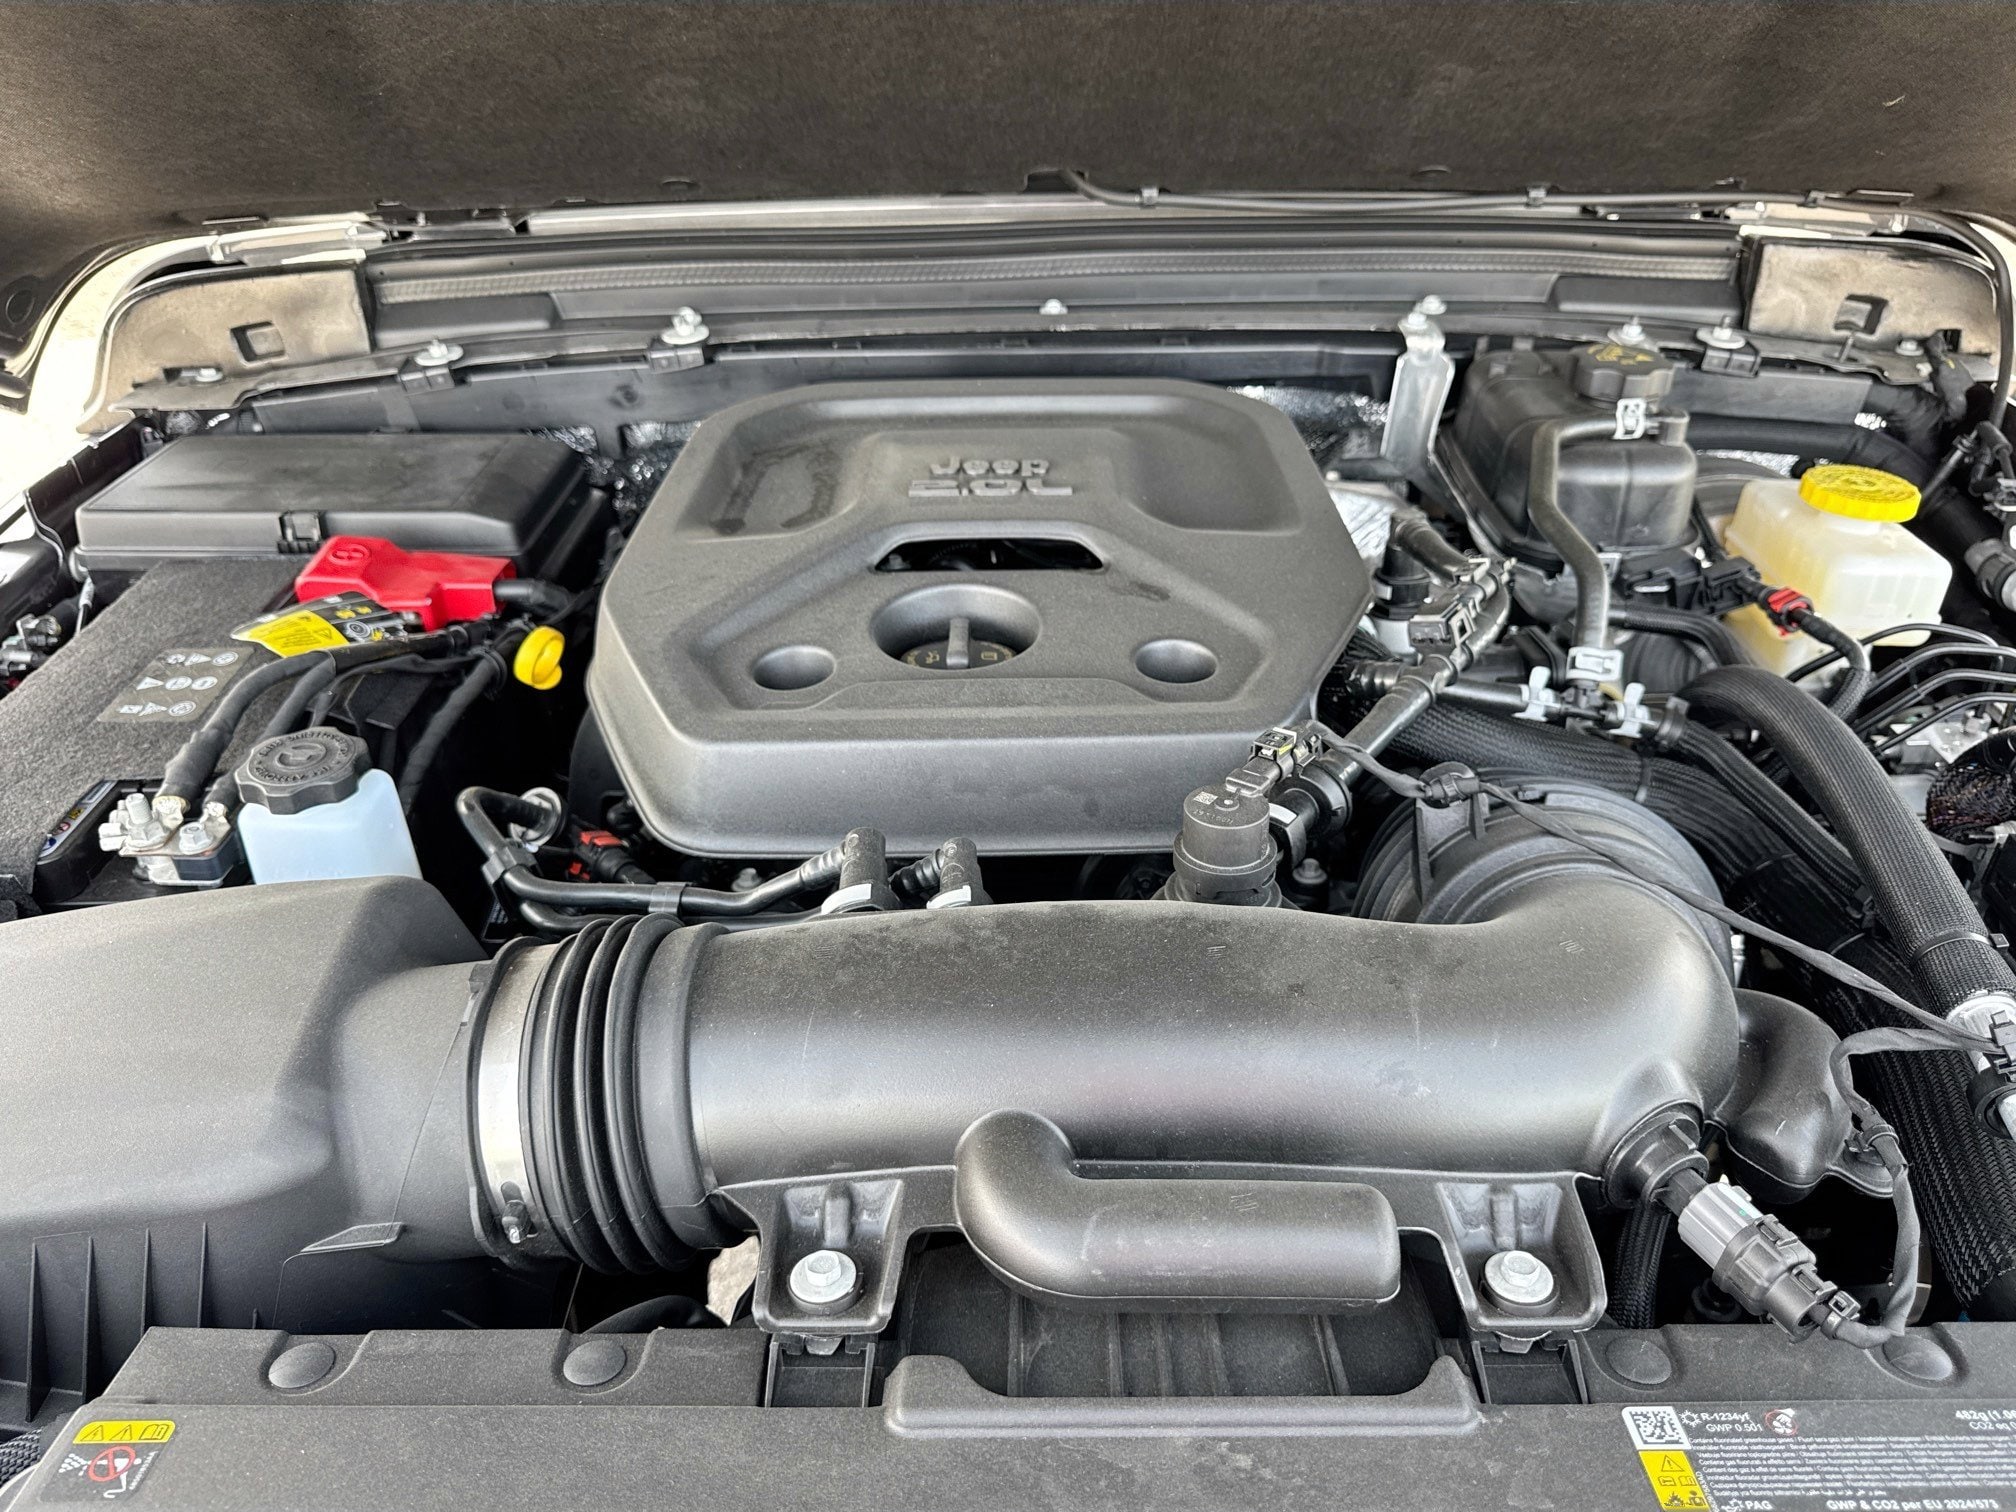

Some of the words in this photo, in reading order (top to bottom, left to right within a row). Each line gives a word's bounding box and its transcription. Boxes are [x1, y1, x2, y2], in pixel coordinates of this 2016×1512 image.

[930, 456, 1050, 477] Jeep
[908, 477, 1074, 497] 2.0L
[1700, 1412, 1751, 1422] R-1234yf
[1955, 1410, 1989, 1421] 482g
[1706, 1423, 1733, 1432] GWP
[1735, 1423, 1763, 1432] 0.501
[1969, 1421, 1994, 1430] CO2
[1995, 1423, 2011, 1431] eq
[1746, 1500, 1773, 1510] PAG
[1826, 1500, 1857, 1510] GWP
[1860, 1500, 1871, 1510] &
[1871, 1500, 1900, 1510] CO2
[1901, 1501, 1921, 1512] per
[1922, 1499, 1943, 1509] EU
[1943, 1499, 1999, 1510] 2024/573
